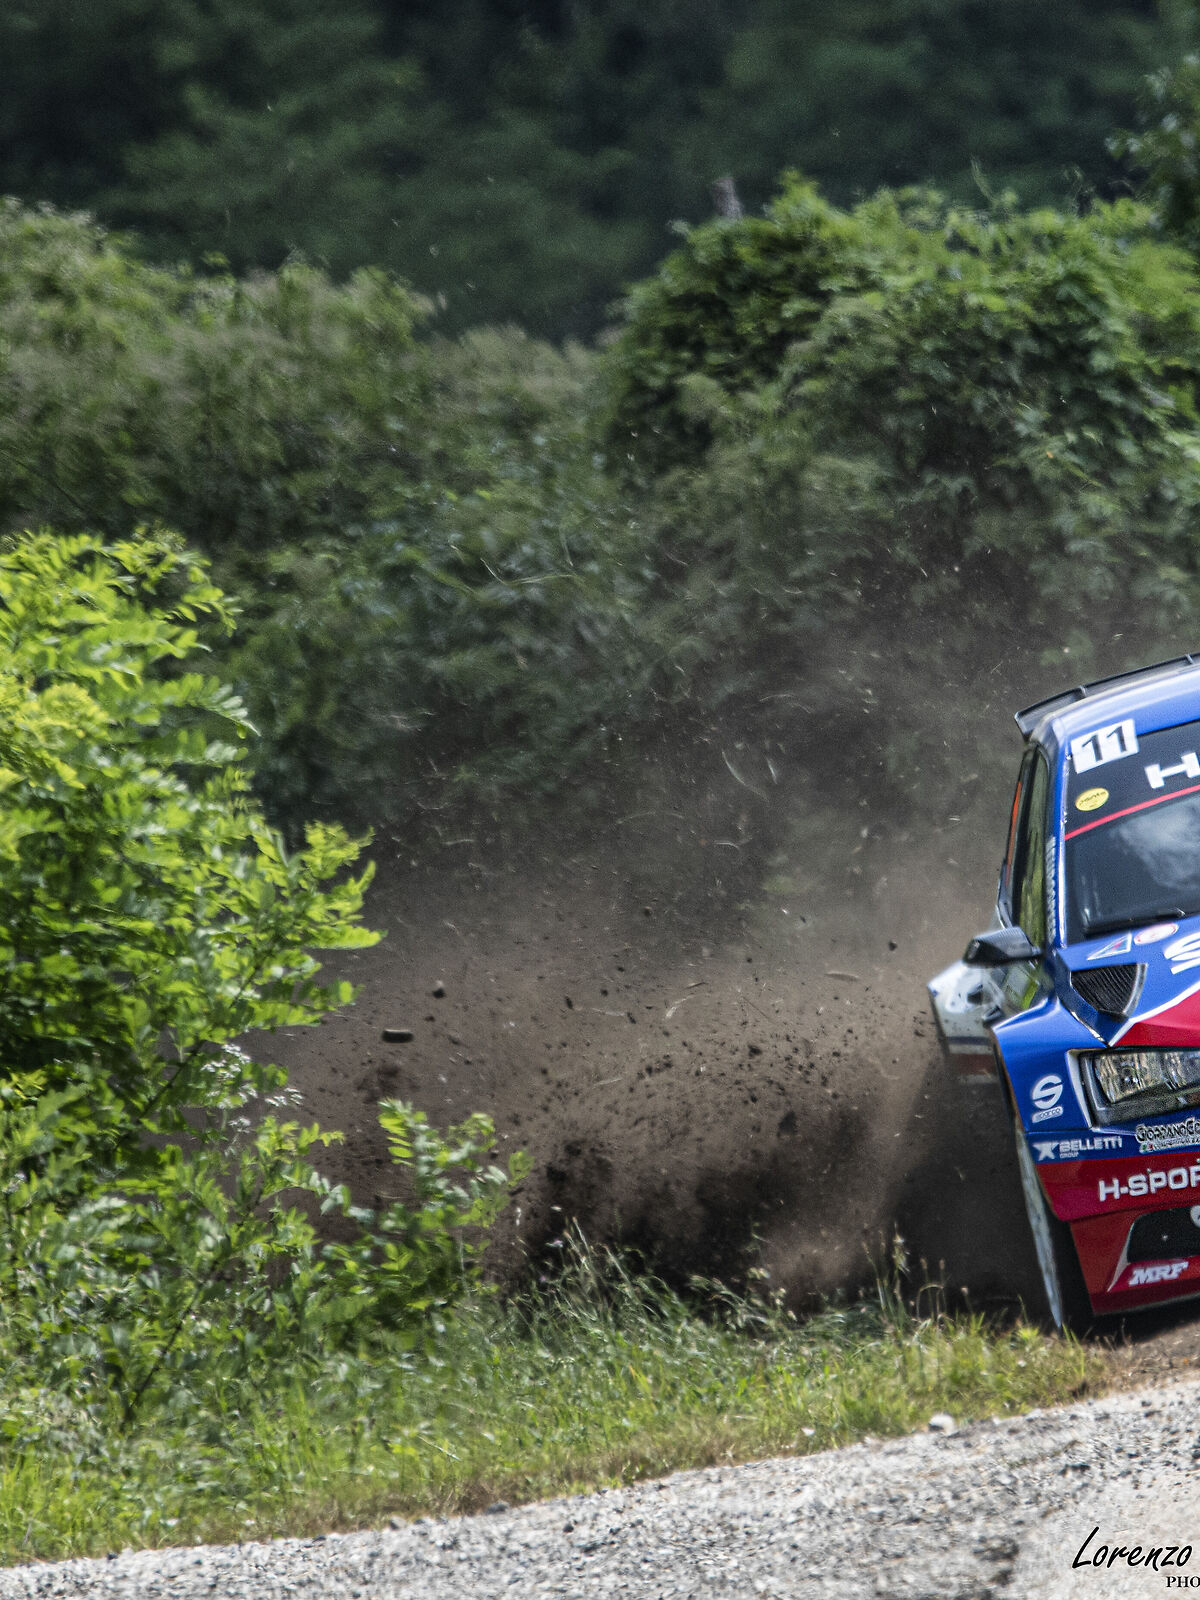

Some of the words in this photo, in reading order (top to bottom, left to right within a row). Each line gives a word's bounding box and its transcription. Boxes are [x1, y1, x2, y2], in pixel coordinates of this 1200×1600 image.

[1082, 726, 1128, 762] 11
[1059, 1135, 1123, 1153] BELLETTI
[1128, 1261, 1189, 1287] MRF
